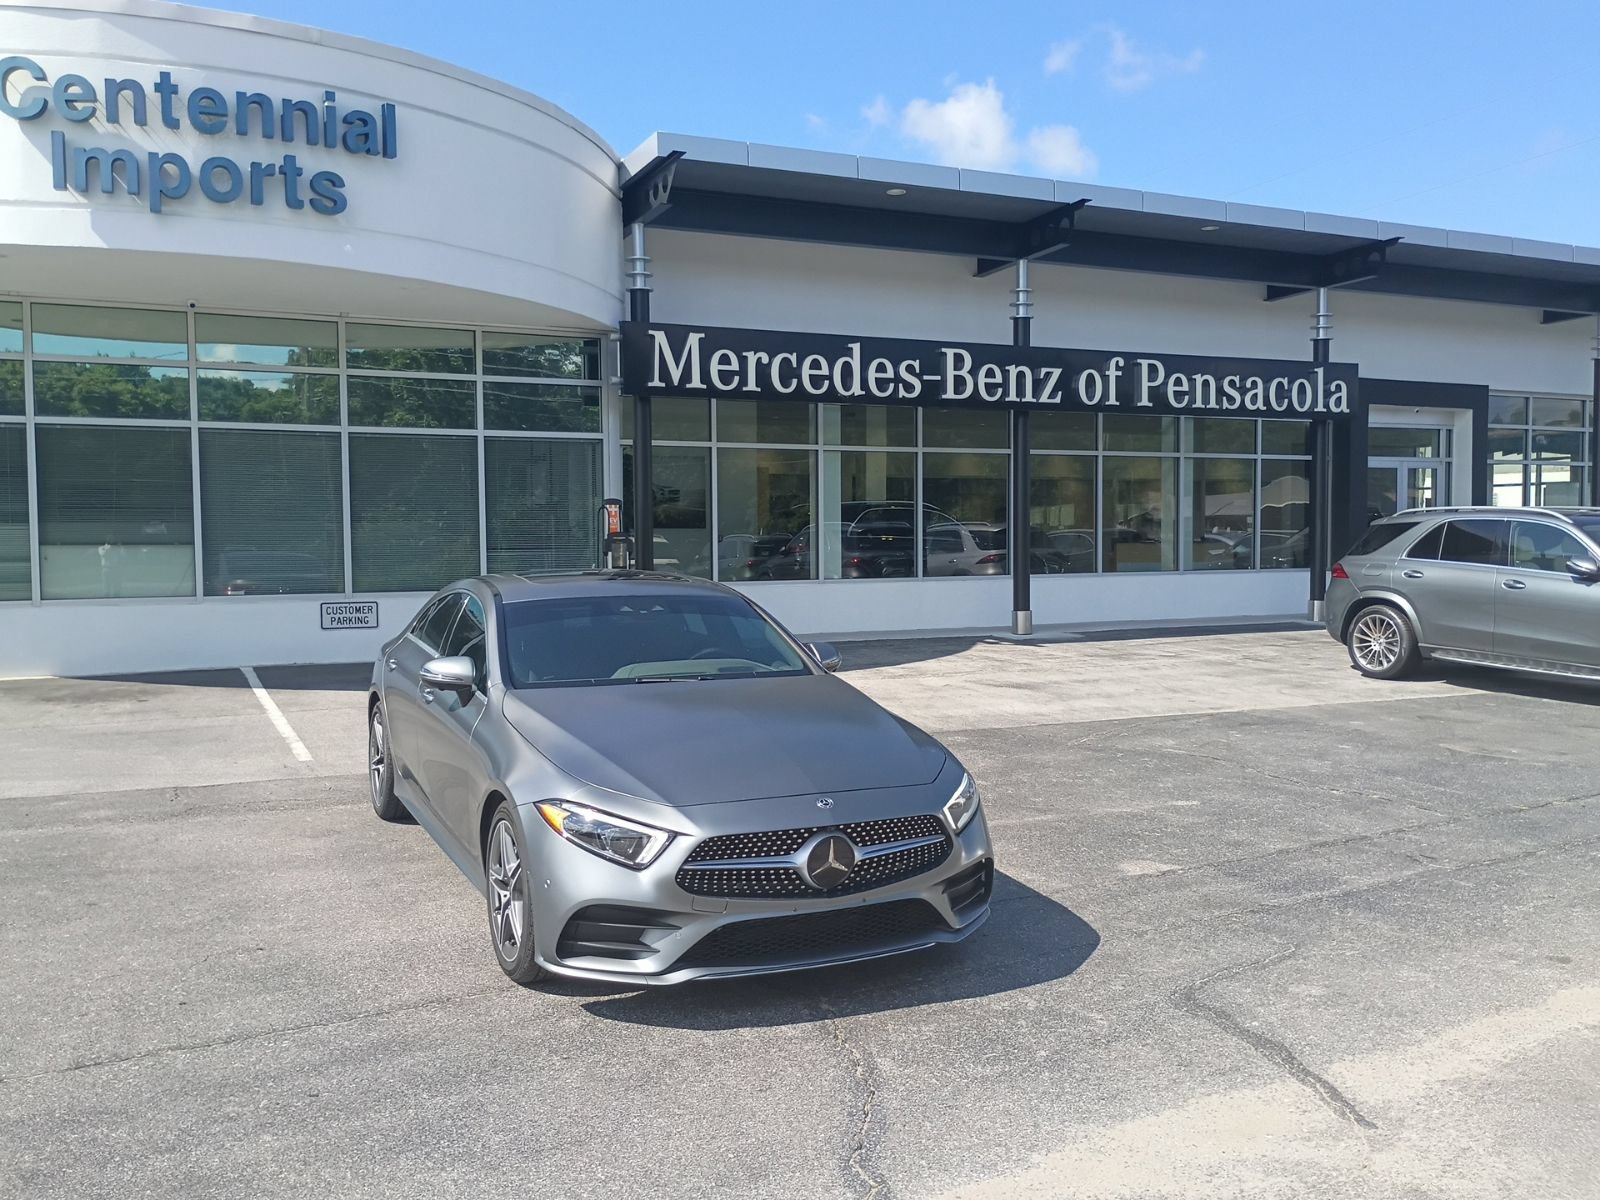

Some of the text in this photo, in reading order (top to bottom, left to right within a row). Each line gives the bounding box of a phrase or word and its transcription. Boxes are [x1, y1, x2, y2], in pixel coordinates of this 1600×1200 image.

[0, 56, 397, 159] Centennial
[51, 130, 348, 216] Imports
[647, 329, 1350, 414] Mercedes-Benz of Pensacola
[326, 605, 373, 615] CUSTOMER
[330, 616, 369, 625] PARKING
